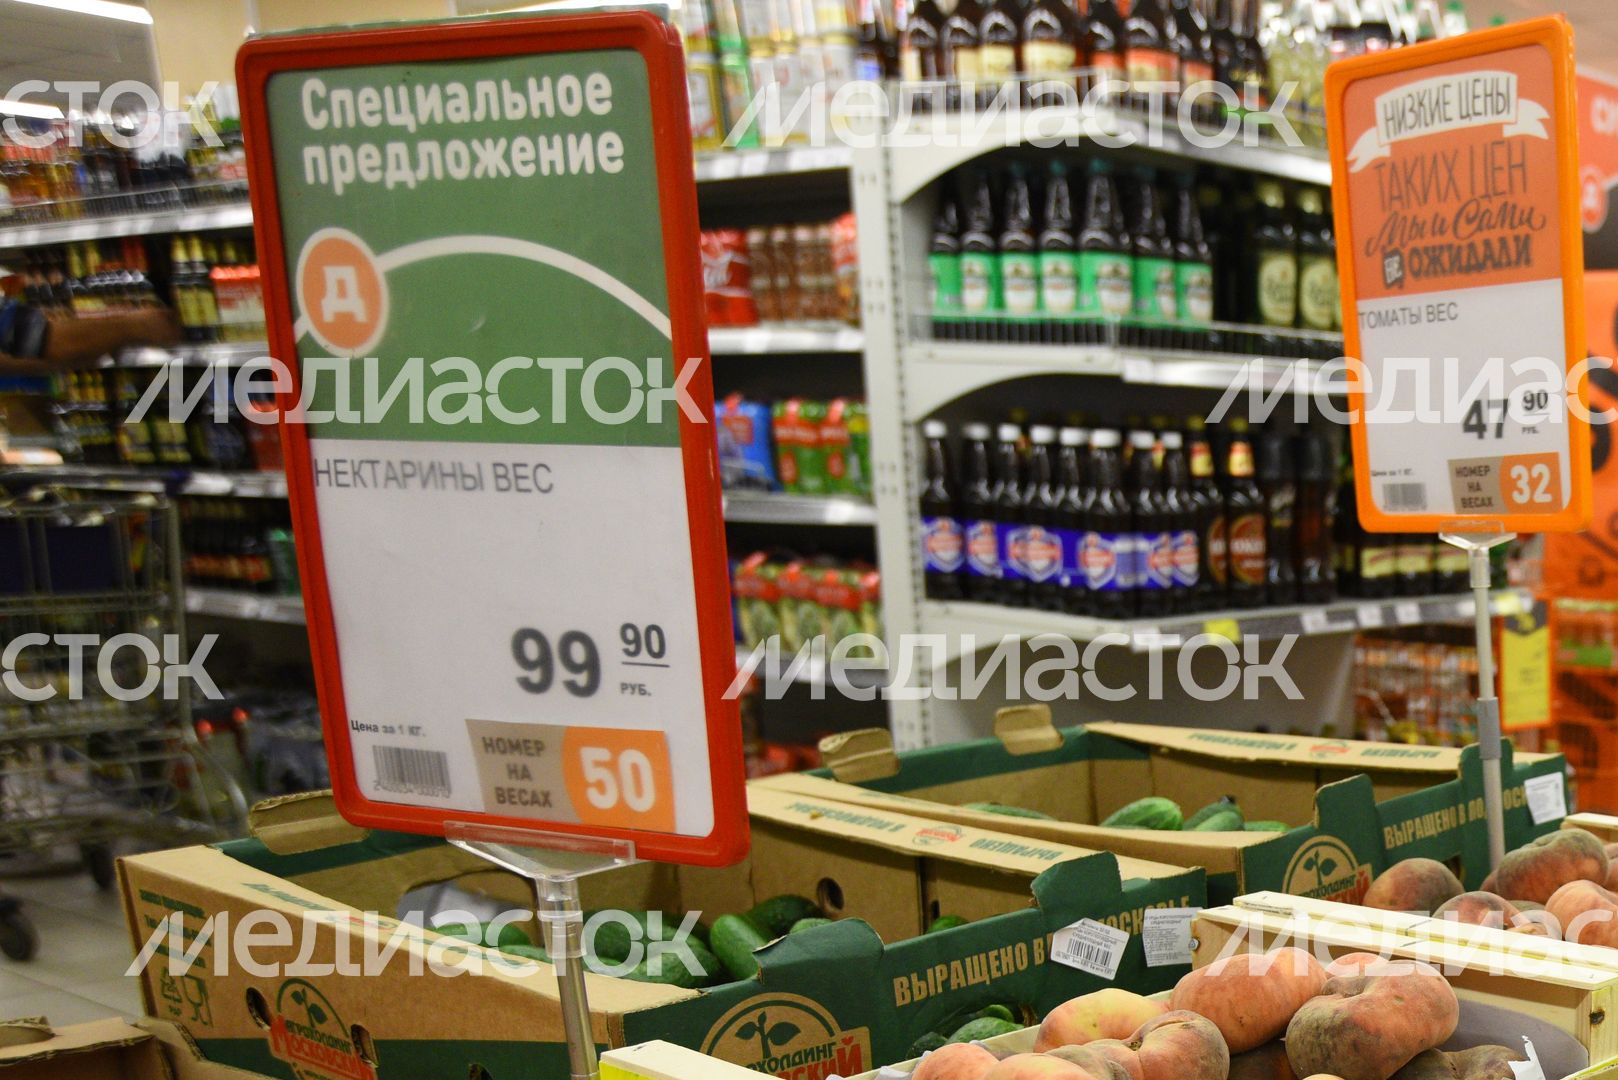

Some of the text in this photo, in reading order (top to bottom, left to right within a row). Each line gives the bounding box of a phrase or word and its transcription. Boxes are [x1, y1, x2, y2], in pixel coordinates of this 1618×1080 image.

[302, 70, 613, 131] Специальное
[1383, 77, 1511, 140] НИЗКИЕ ЦЕНЫ
[303, 127, 625, 195] предложение
[1375, 149, 1461, 212] ТАКИХ
[1469, 139, 1528, 204] ЦЕН
[1408, 233, 1533, 280] ОЖИДАЛИ
[1358, 302, 1459, 331] ТОМАТЫ ВЕС
[1462, 389, 1550, 440] 47 90
[314, 458, 554, 495] НЕКТАРИНЫ ВЕС
[1467, 481, 1482, 492] НА
[1510, 463, 1553, 503] 32
[511, 622, 666, 699] 99 90
[620, 681, 652, 698] РУБ.
[351, 720, 379, 733] Цена
[482, 736, 546, 757] НОМЕР
[507, 763, 533, 781] НА
[579, 746, 656, 814] 50
[495, 786, 553, 809] ВЕСАХ
[1383, 804, 1457, 850] ВЫРАЩЕНО
[1458, 803, 1466, 826] В
[893, 942, 1029, 1008] ВЫРАЩЕНО
[1032, 938, 1046, 966] В
